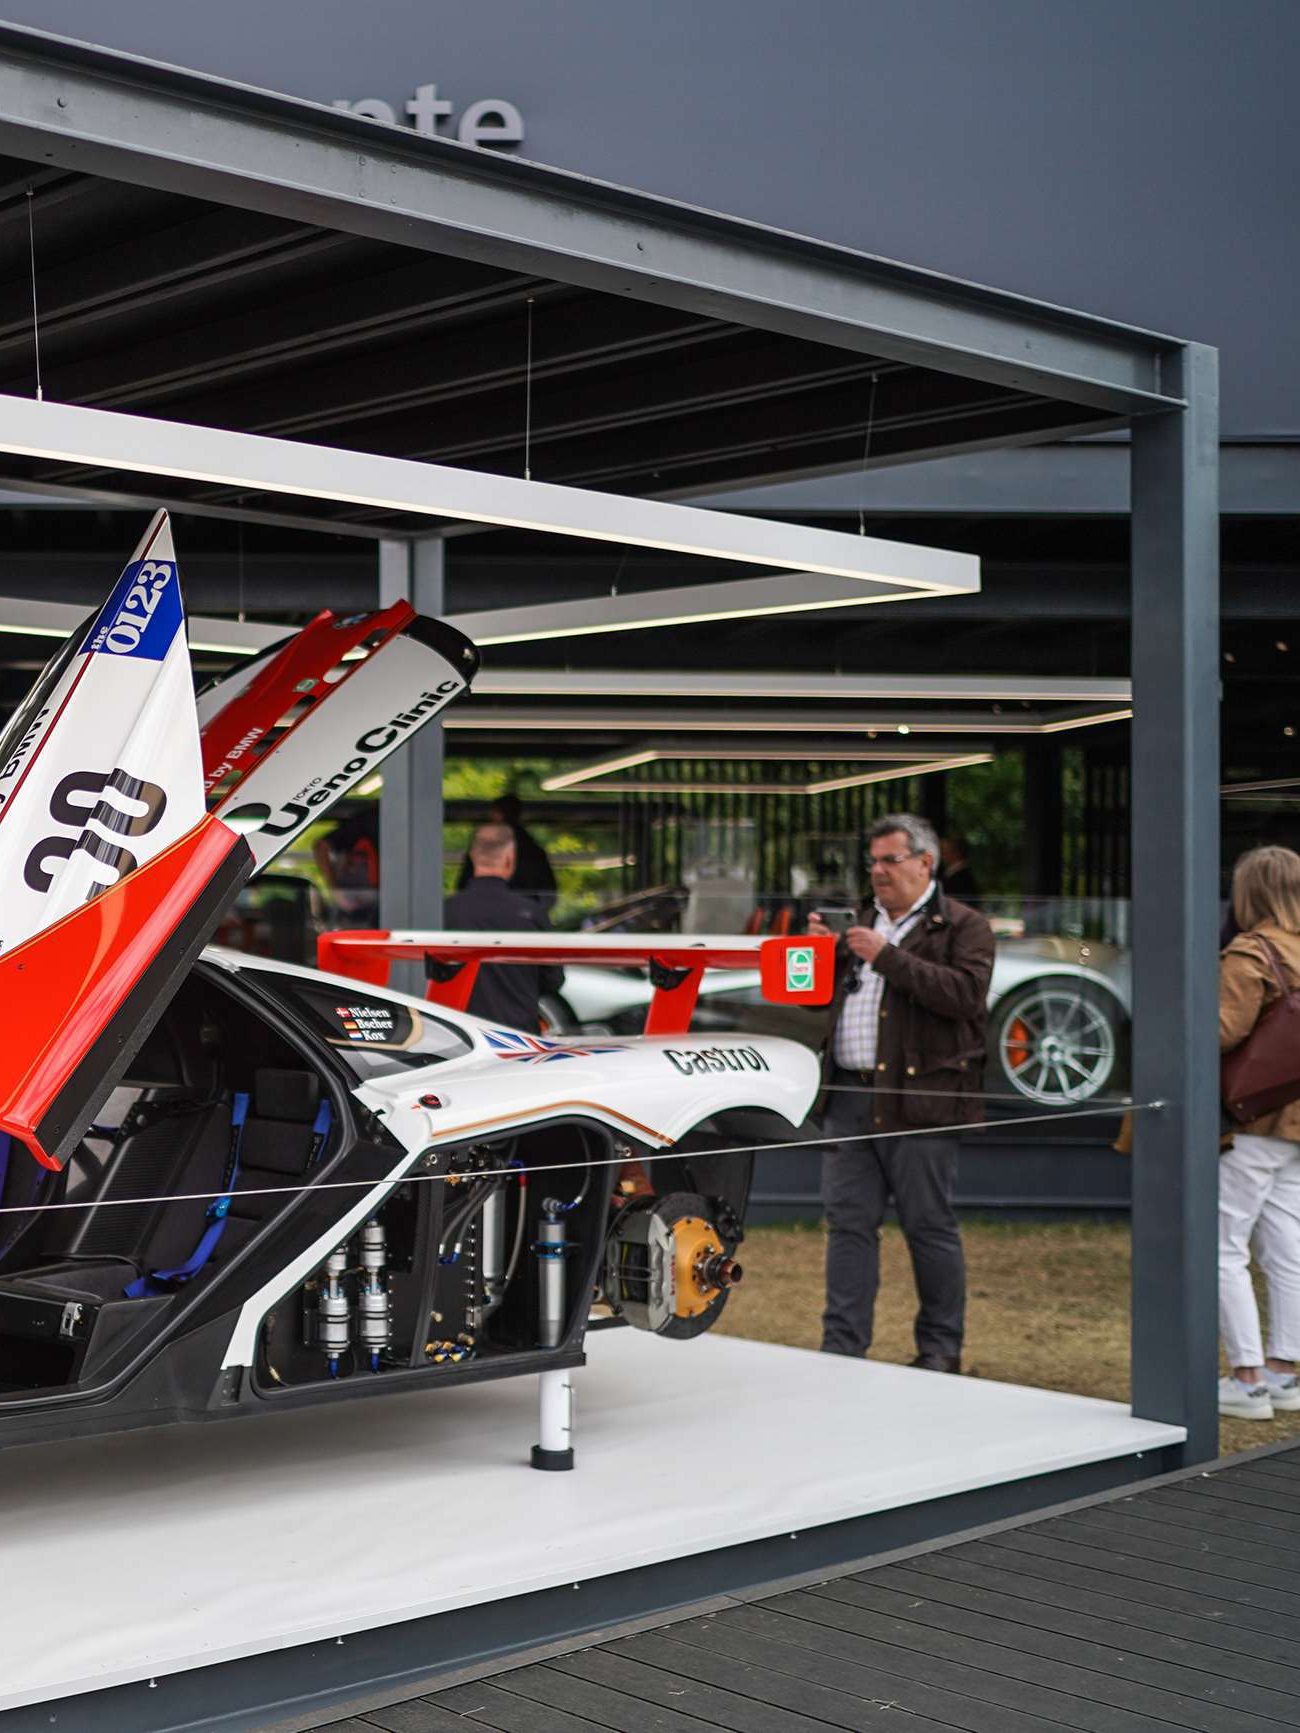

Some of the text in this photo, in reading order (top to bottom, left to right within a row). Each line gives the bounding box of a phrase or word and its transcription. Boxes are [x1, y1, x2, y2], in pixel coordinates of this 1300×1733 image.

[106, 562, 172, 653] 0123
[226, 728, 263, 759] BMW
[293, 776, 322, 800] TOKYO
[23, 768, 167, 901] 30
[348, 1007, 391, 1018] Nielsen
[355, 1018, 394, 1029] Bscher
[361, 1029, 387, 1041] Kox
[662, 1046, 770, 1076] Castrol
